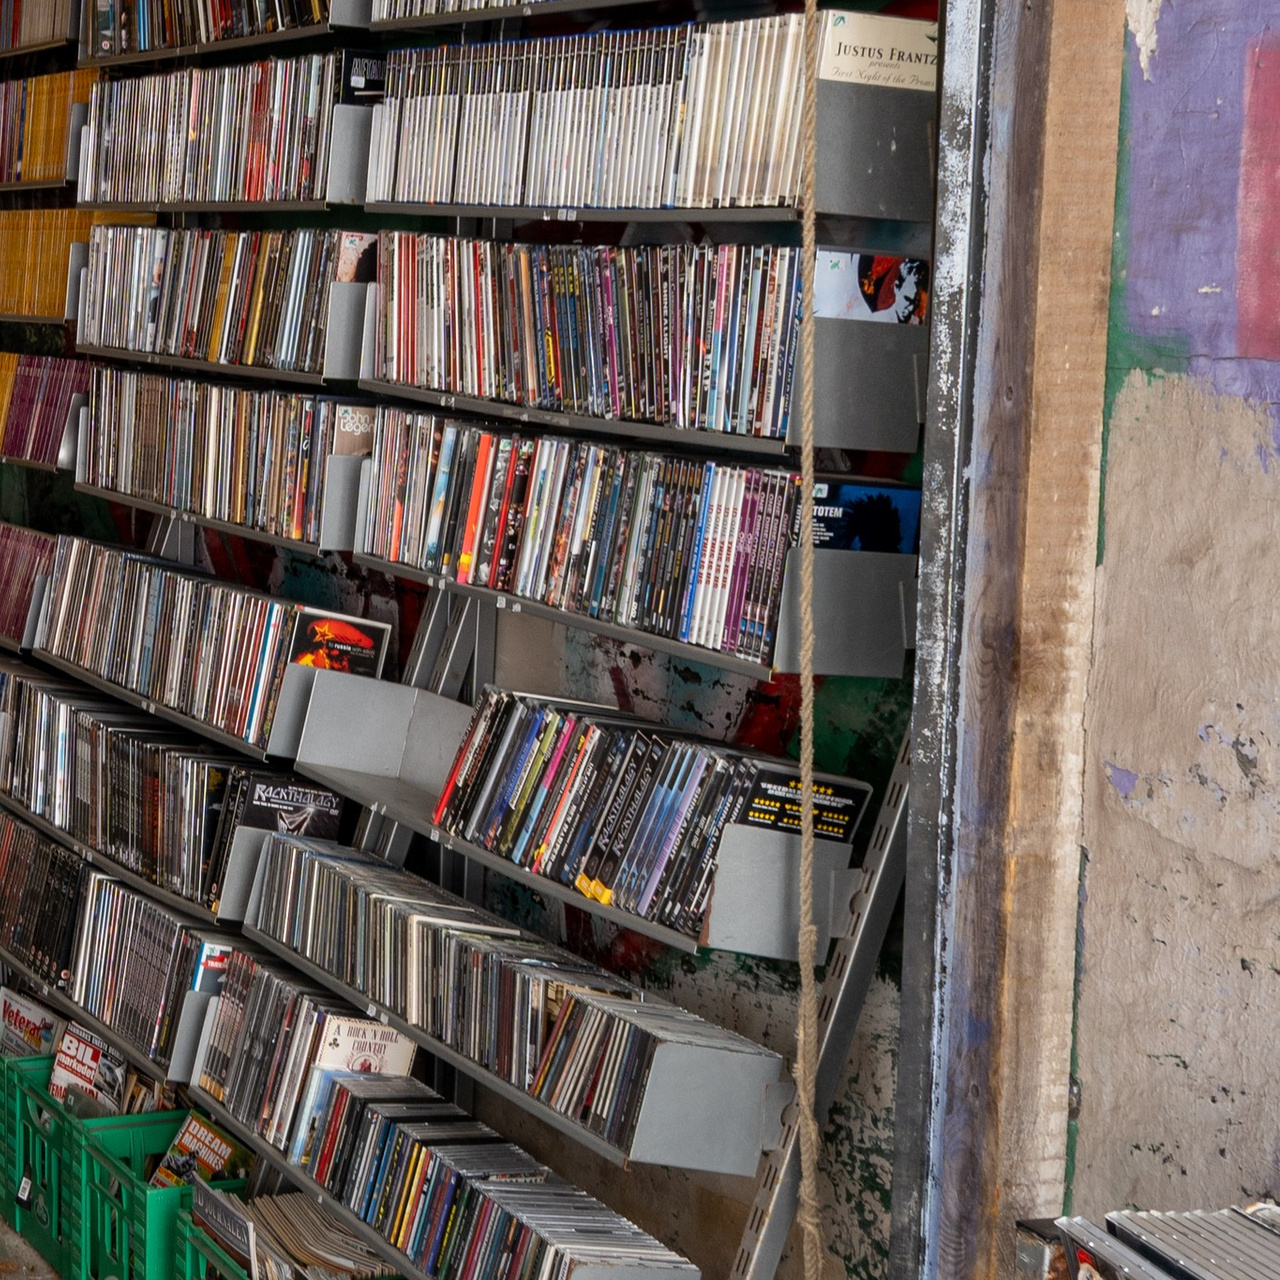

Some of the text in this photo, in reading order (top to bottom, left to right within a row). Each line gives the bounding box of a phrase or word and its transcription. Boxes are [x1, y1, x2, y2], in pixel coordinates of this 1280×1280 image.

[835, 42, 883, 59] JUSTUS
[894, 74, 906, 84] the
[813, 505, 843, 518] TOTEM
[335, 643, 351, 651] russia
[684, 786, 702, 821] SHINE
[715, 793, 734, 829] SHINE
[334, 1024, 341, 1036] A
[347, 1026, 368, 1039] ROCK
[379, 1031, 399, 1043] ROLL
[61, 1035, 98, 1066] BIL
[352, 1040, 388, 1056] COUNTRY
[58, 1053, 95, 1079] markedet
